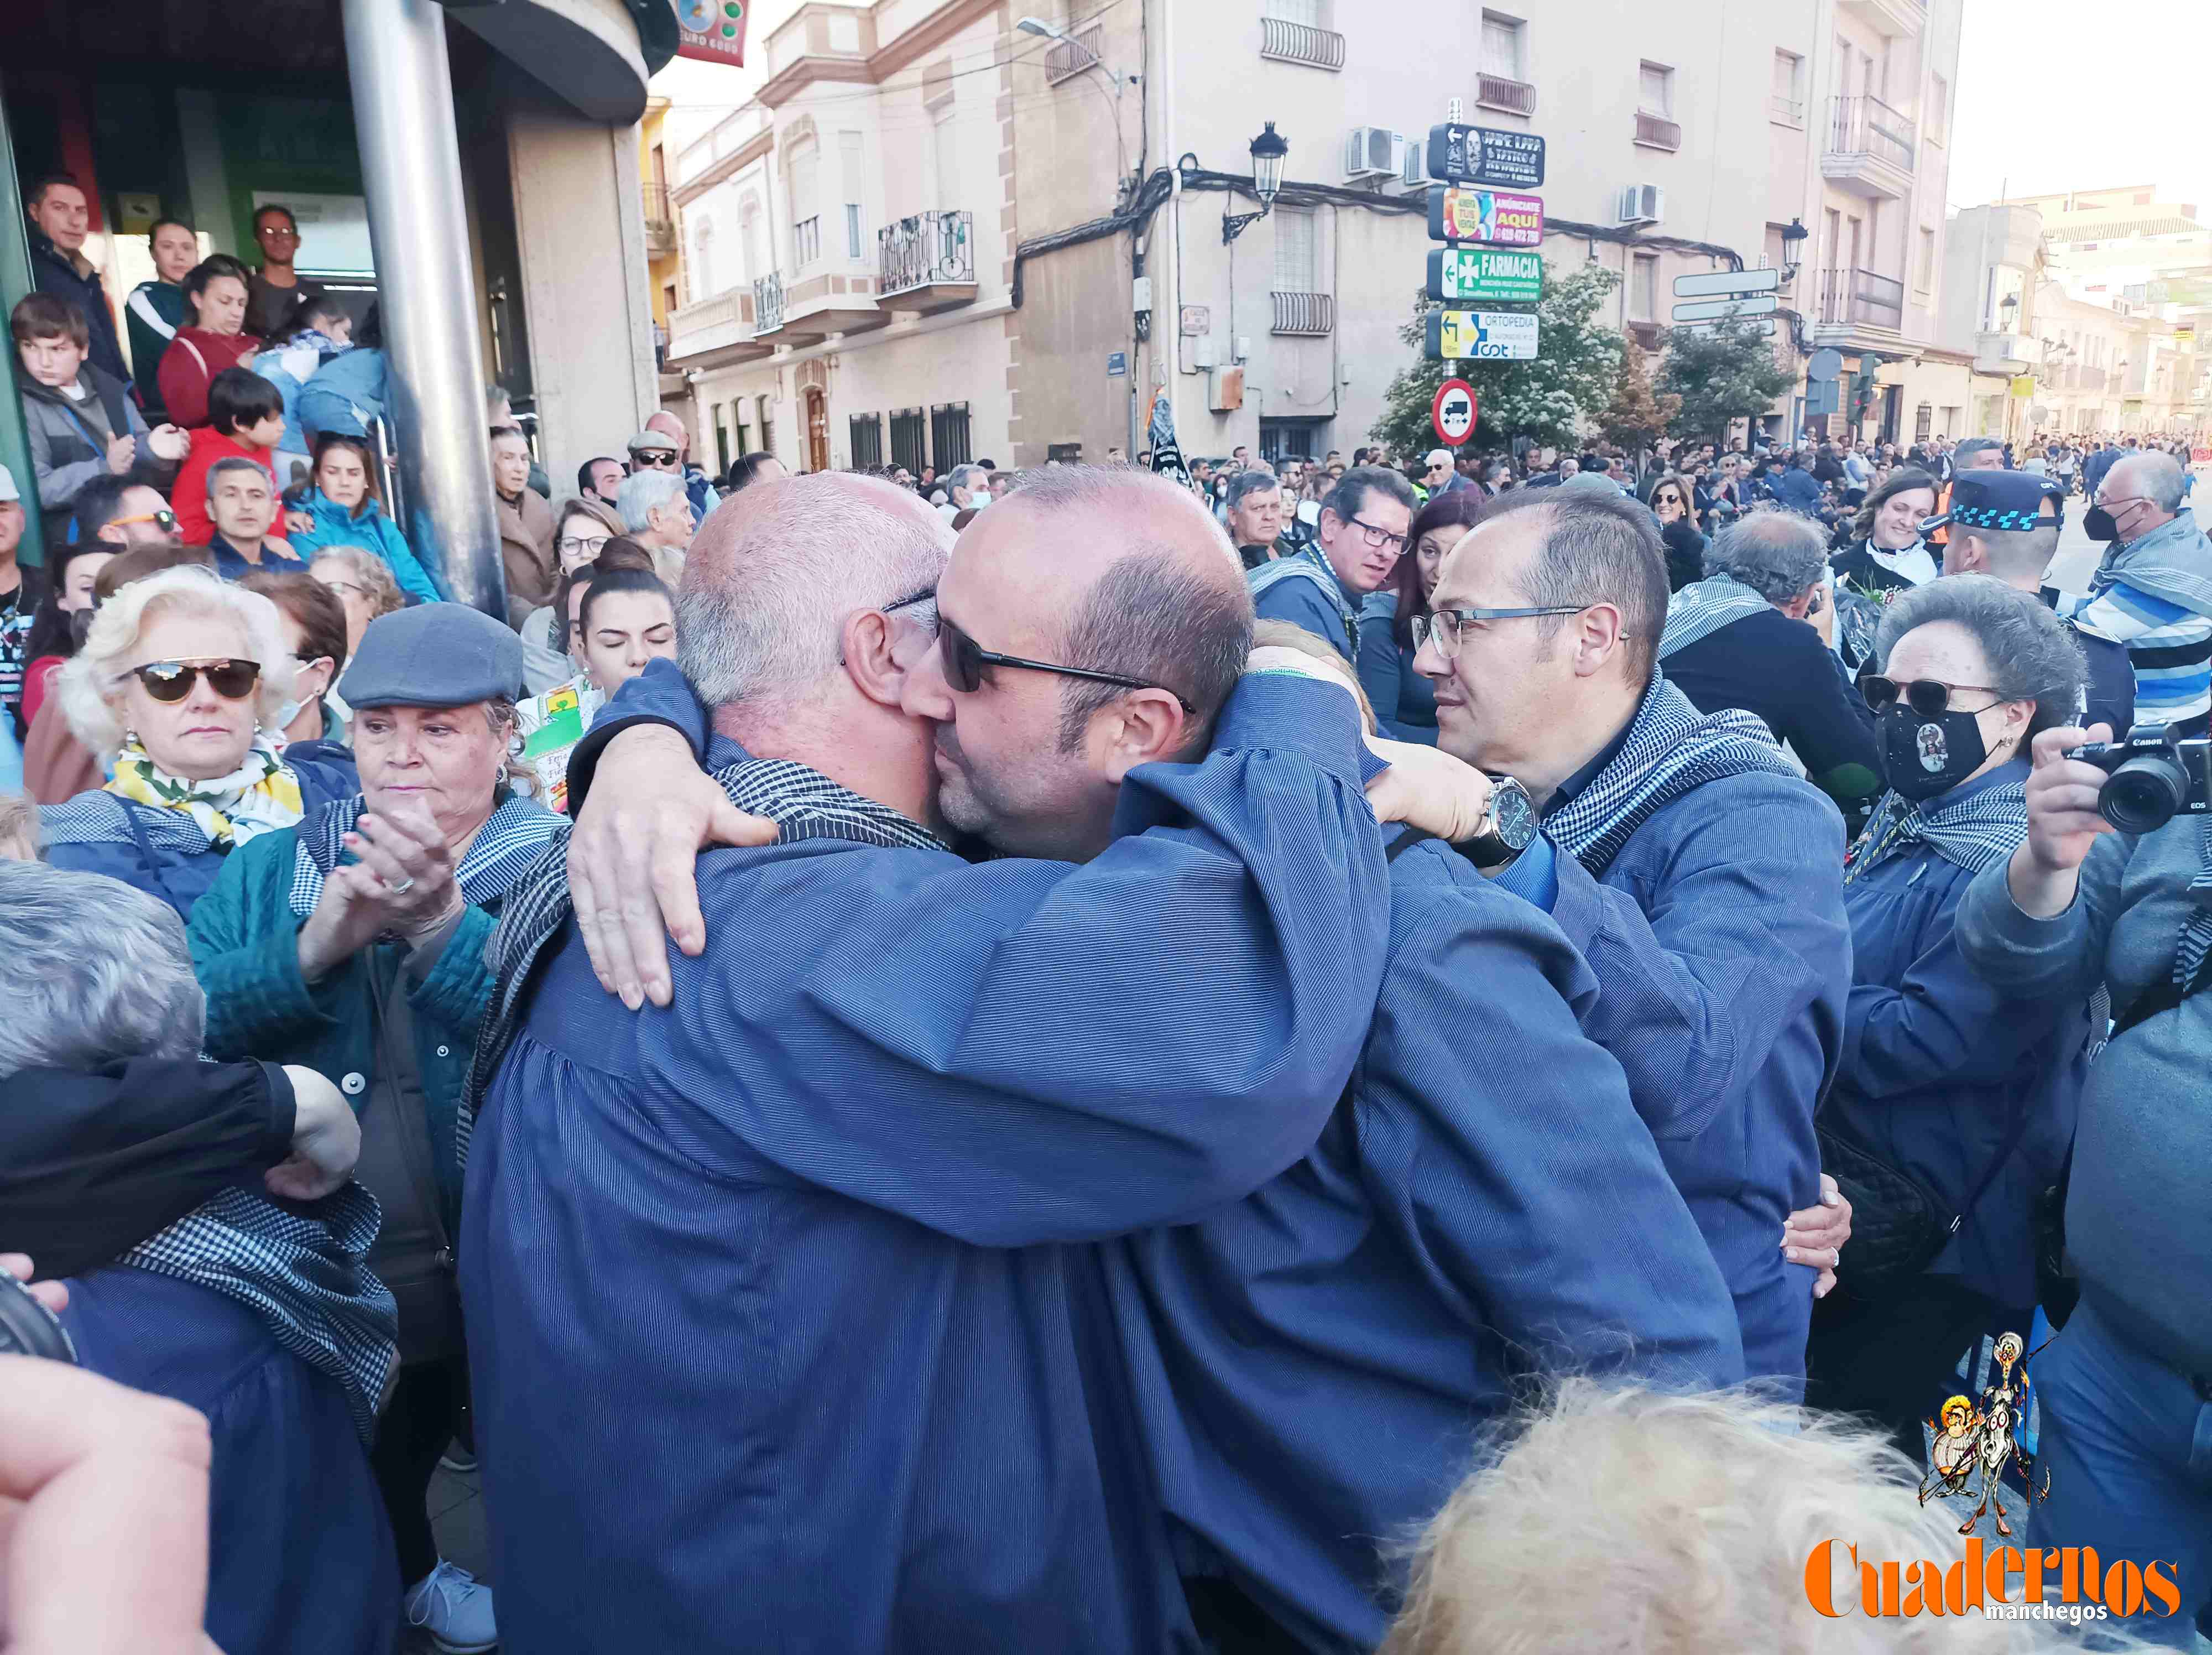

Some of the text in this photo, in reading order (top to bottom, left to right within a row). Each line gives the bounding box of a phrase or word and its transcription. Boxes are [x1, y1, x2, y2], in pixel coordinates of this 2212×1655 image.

[1497, 212, 1540, 228] AQUÍ
[1481, 254, 1540, 279] FARMACIA
[1485, 315, 1534, 327] ORTOPEDIA
